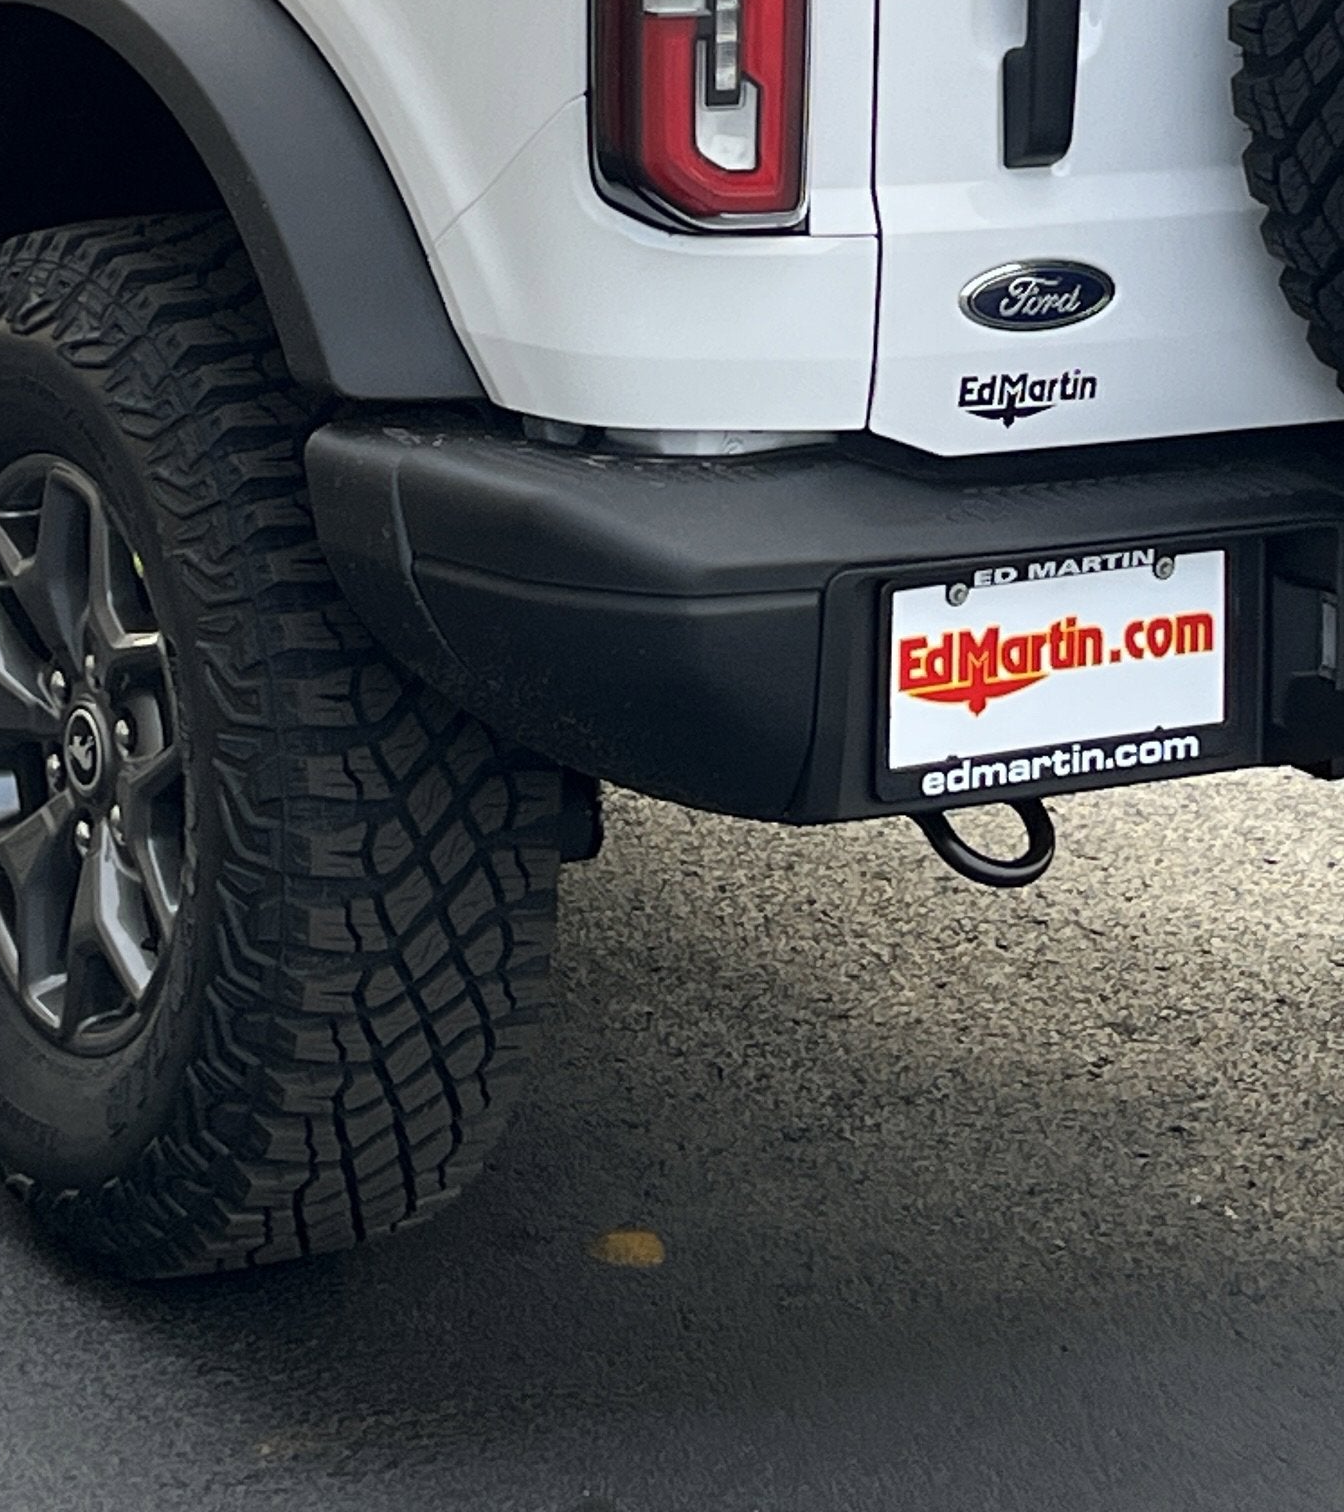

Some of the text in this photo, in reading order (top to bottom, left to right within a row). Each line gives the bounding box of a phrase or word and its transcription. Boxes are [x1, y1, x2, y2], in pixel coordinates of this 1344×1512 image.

[998, 275, 1083, 319] Ford
[972, 548, 1156, 588] ED MARTIN
[898, 612, 1215, 694] EdMartin.com
[921, 733, 1201, 796] edmartin.com
